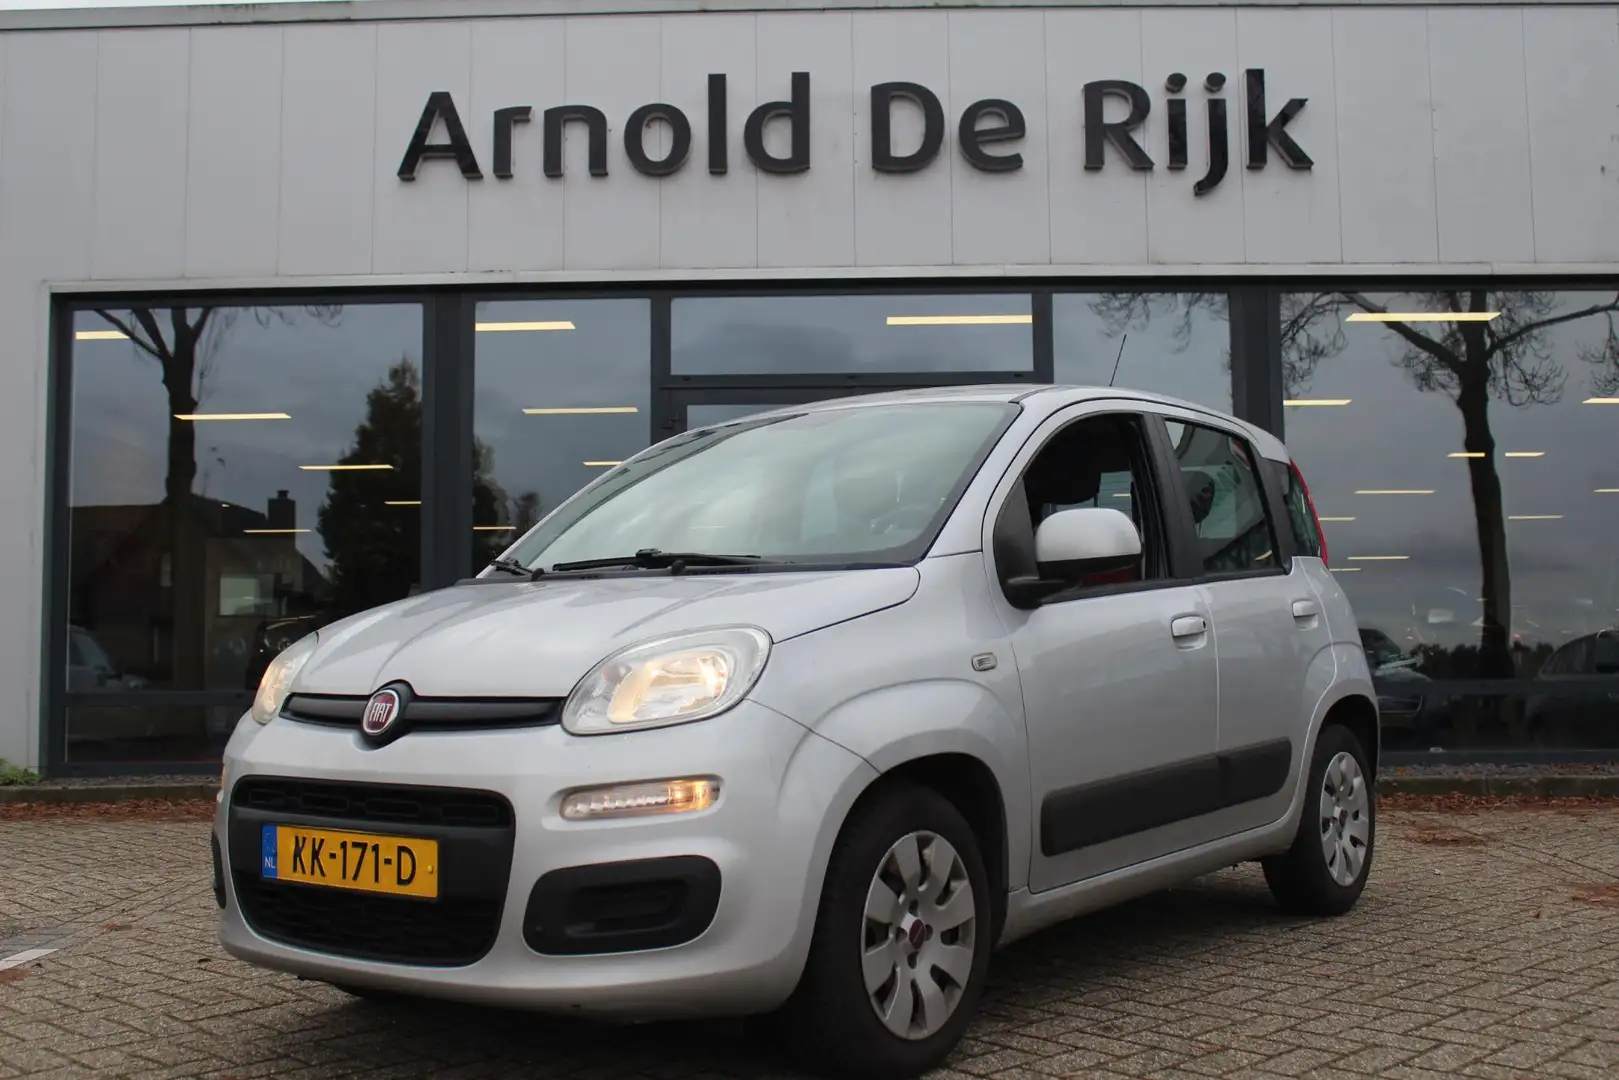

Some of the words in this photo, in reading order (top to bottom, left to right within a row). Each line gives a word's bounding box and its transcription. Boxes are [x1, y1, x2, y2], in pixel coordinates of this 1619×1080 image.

[397, 72, 810, 181] Arnold
[870, 81, 1026, 172] De
[1082, 68, 1314, 196] Rijk
[369, 702, 392, 722] FIAT
[264, 856, 276, 869] NL
[292, 835, 416, 886] KK-171-D
